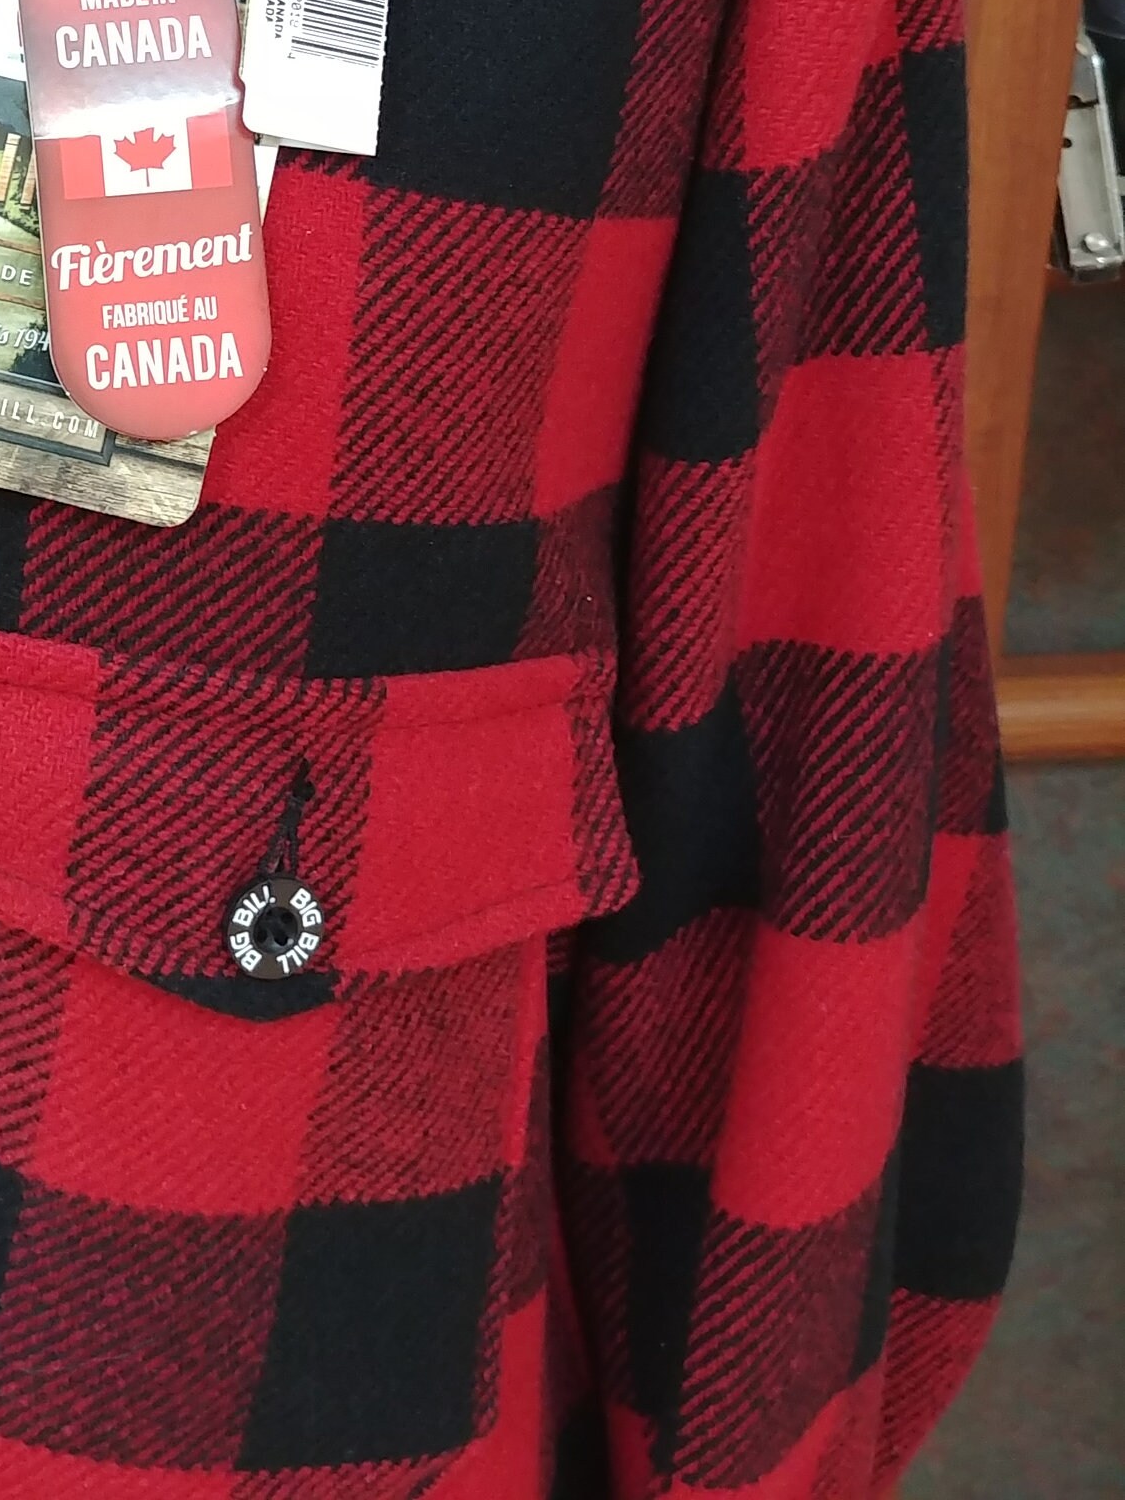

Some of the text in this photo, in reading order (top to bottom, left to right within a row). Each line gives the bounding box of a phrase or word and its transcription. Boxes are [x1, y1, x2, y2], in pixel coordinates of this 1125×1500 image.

[55, 15, 212, 69] CANADA
[0, 264, 35, 286] DE
[51, 223, 253, 291] Fièrement
[102, 295, 218, 329] FABRIQUÉ AU
[86, 332, 243, 391] CANADA
[230, 885, 276, 972] BIG BILL
[276, 887, 322, 973] BIG BILL
